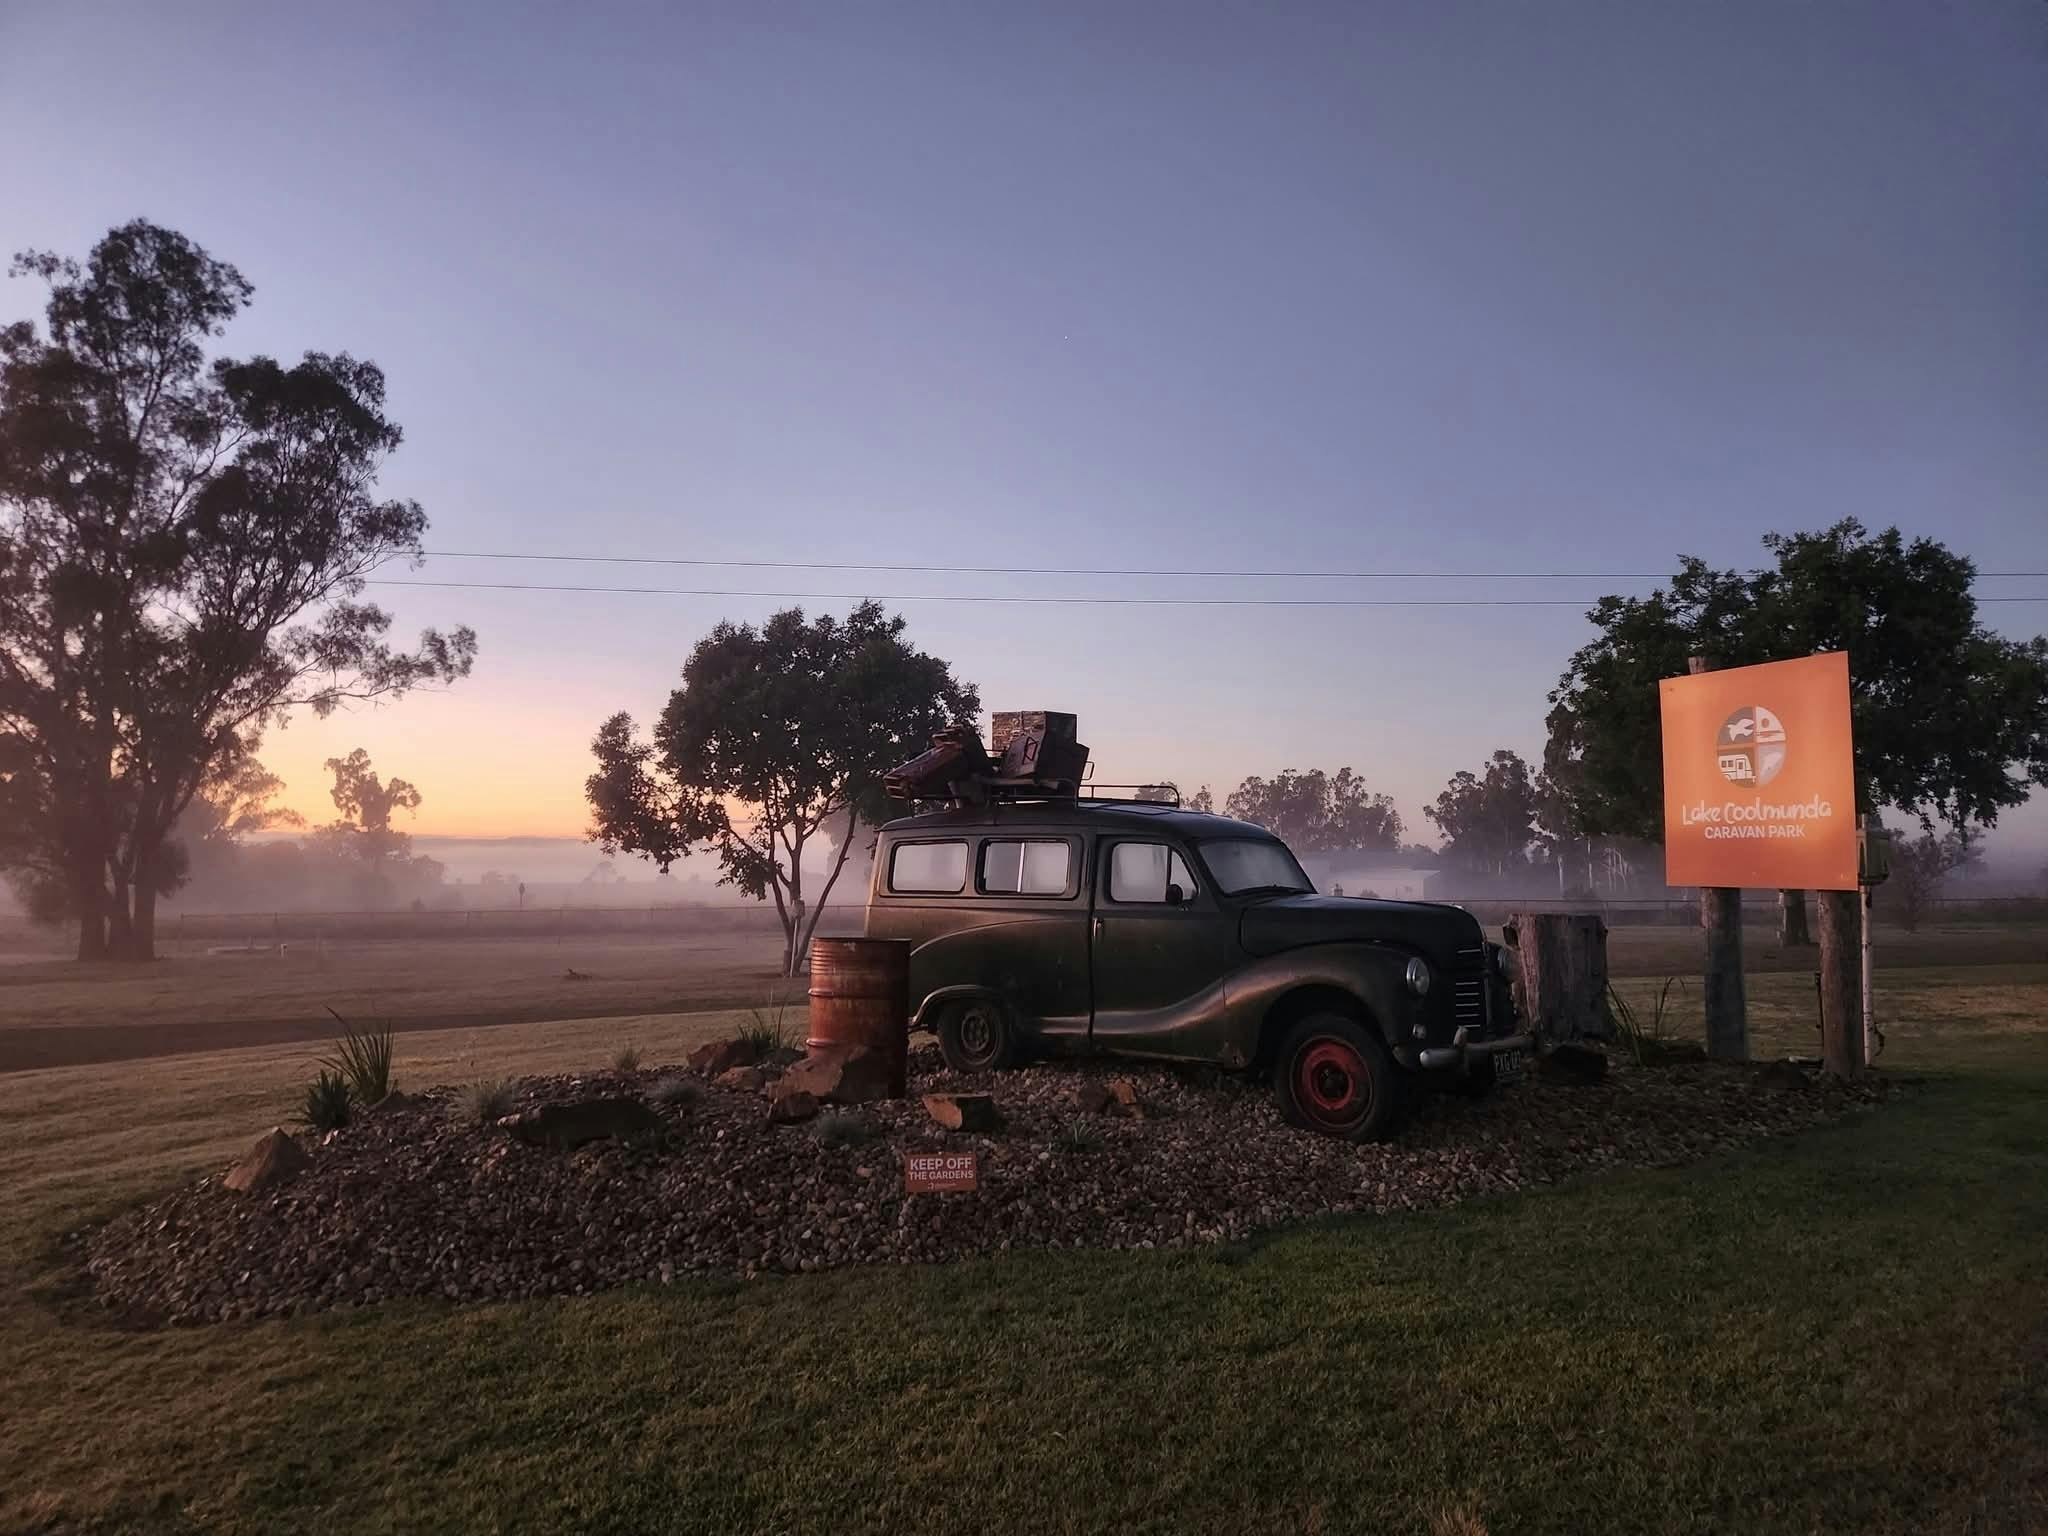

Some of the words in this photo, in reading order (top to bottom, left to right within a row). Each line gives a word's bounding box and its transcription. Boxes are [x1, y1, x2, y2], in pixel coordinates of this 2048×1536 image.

[1682, 800, 1721, 825] Lake
[1724, 794, 1832, 824] Coolmunda
[1704, 826, 1765, 839] CARAVAN
[1768, 824, 1806, 838] PARK
[910, 1158, 943, 1170] KEEP
[946, 1157, 972, 1169] OFF
[909, 1171, 927, 1180] THE
[928, 1170, 974, 1179] GARDENS
